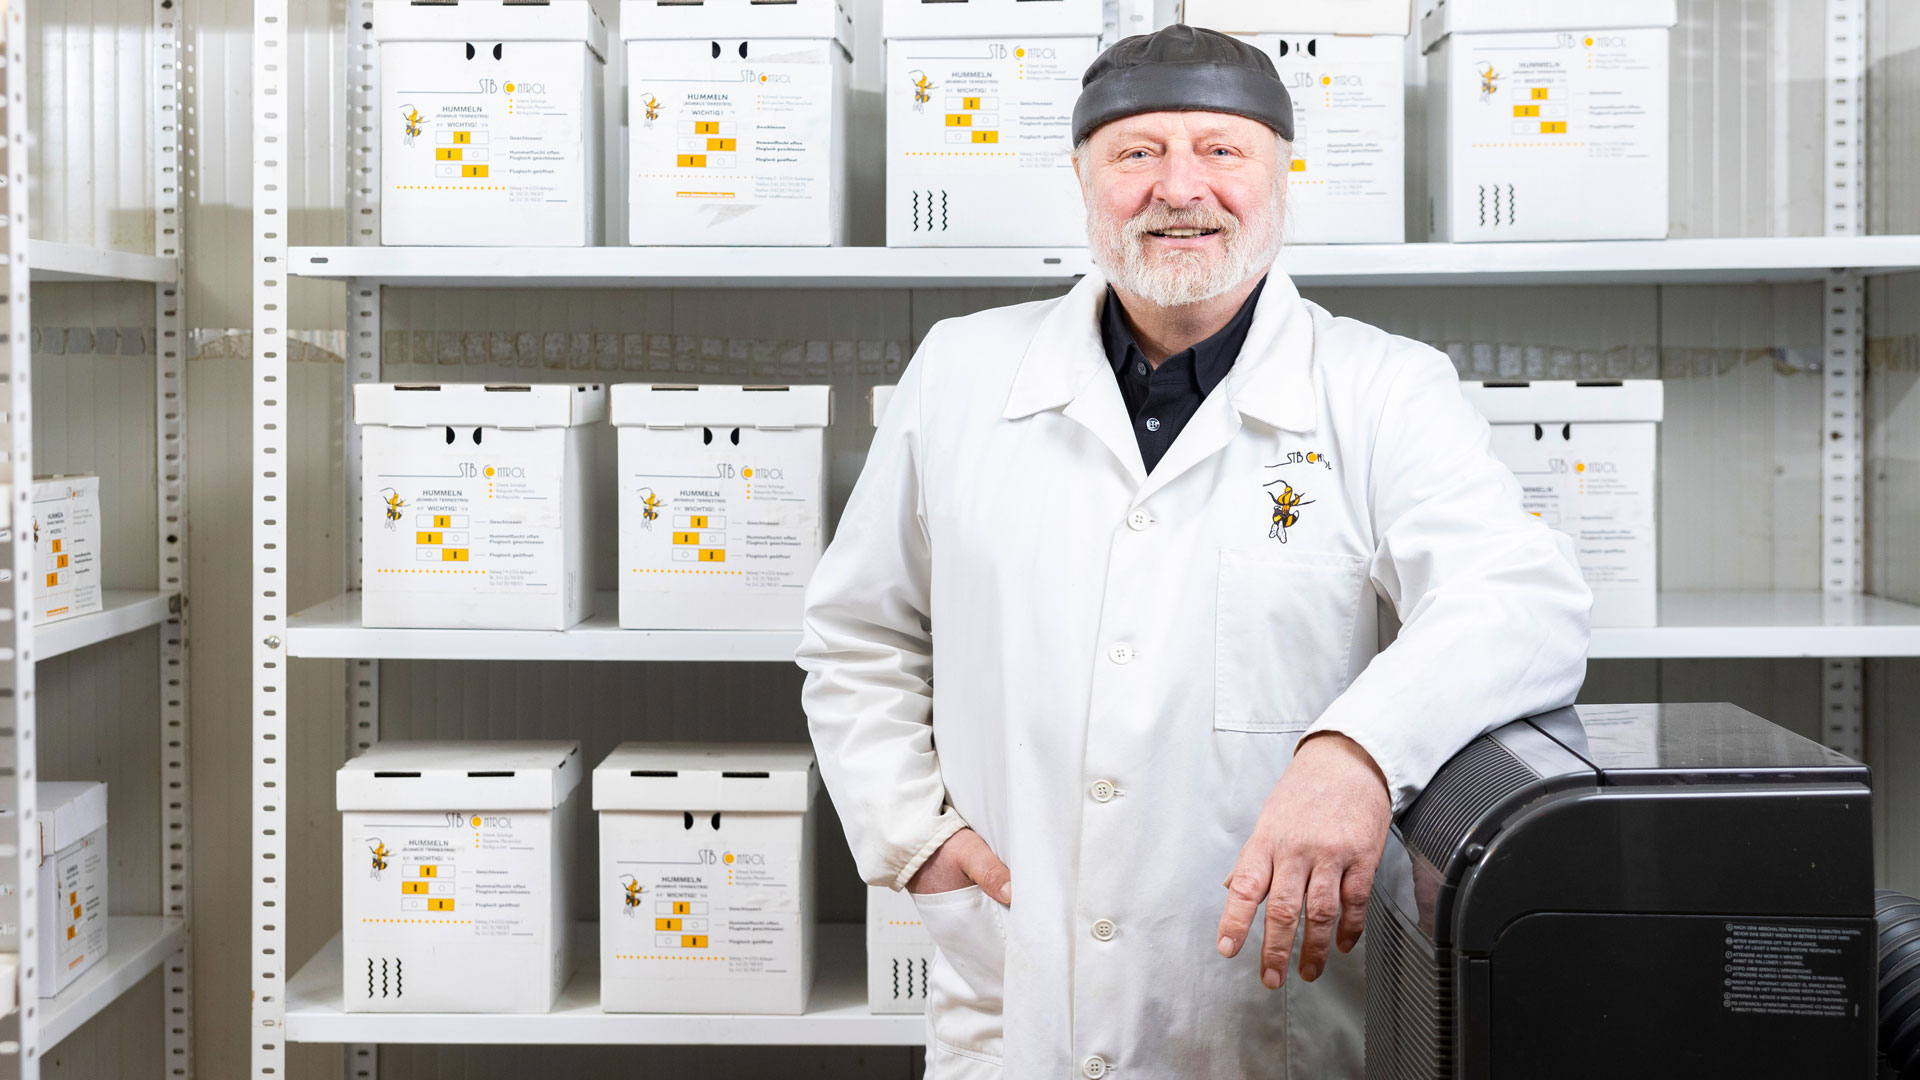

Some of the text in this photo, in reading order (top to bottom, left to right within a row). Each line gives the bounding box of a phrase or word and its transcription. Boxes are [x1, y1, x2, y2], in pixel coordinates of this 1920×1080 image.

[478, 78, 498, 95] STB
[442, 105, 483, 113] HUMMELN
[1286, 451, 1304, 464] STB
[458, 463, 478, 478] STB
[716, 463, 735, 479] STB
[445, 812, 464, 829] STB
[698, 849, 717, 865] STB
